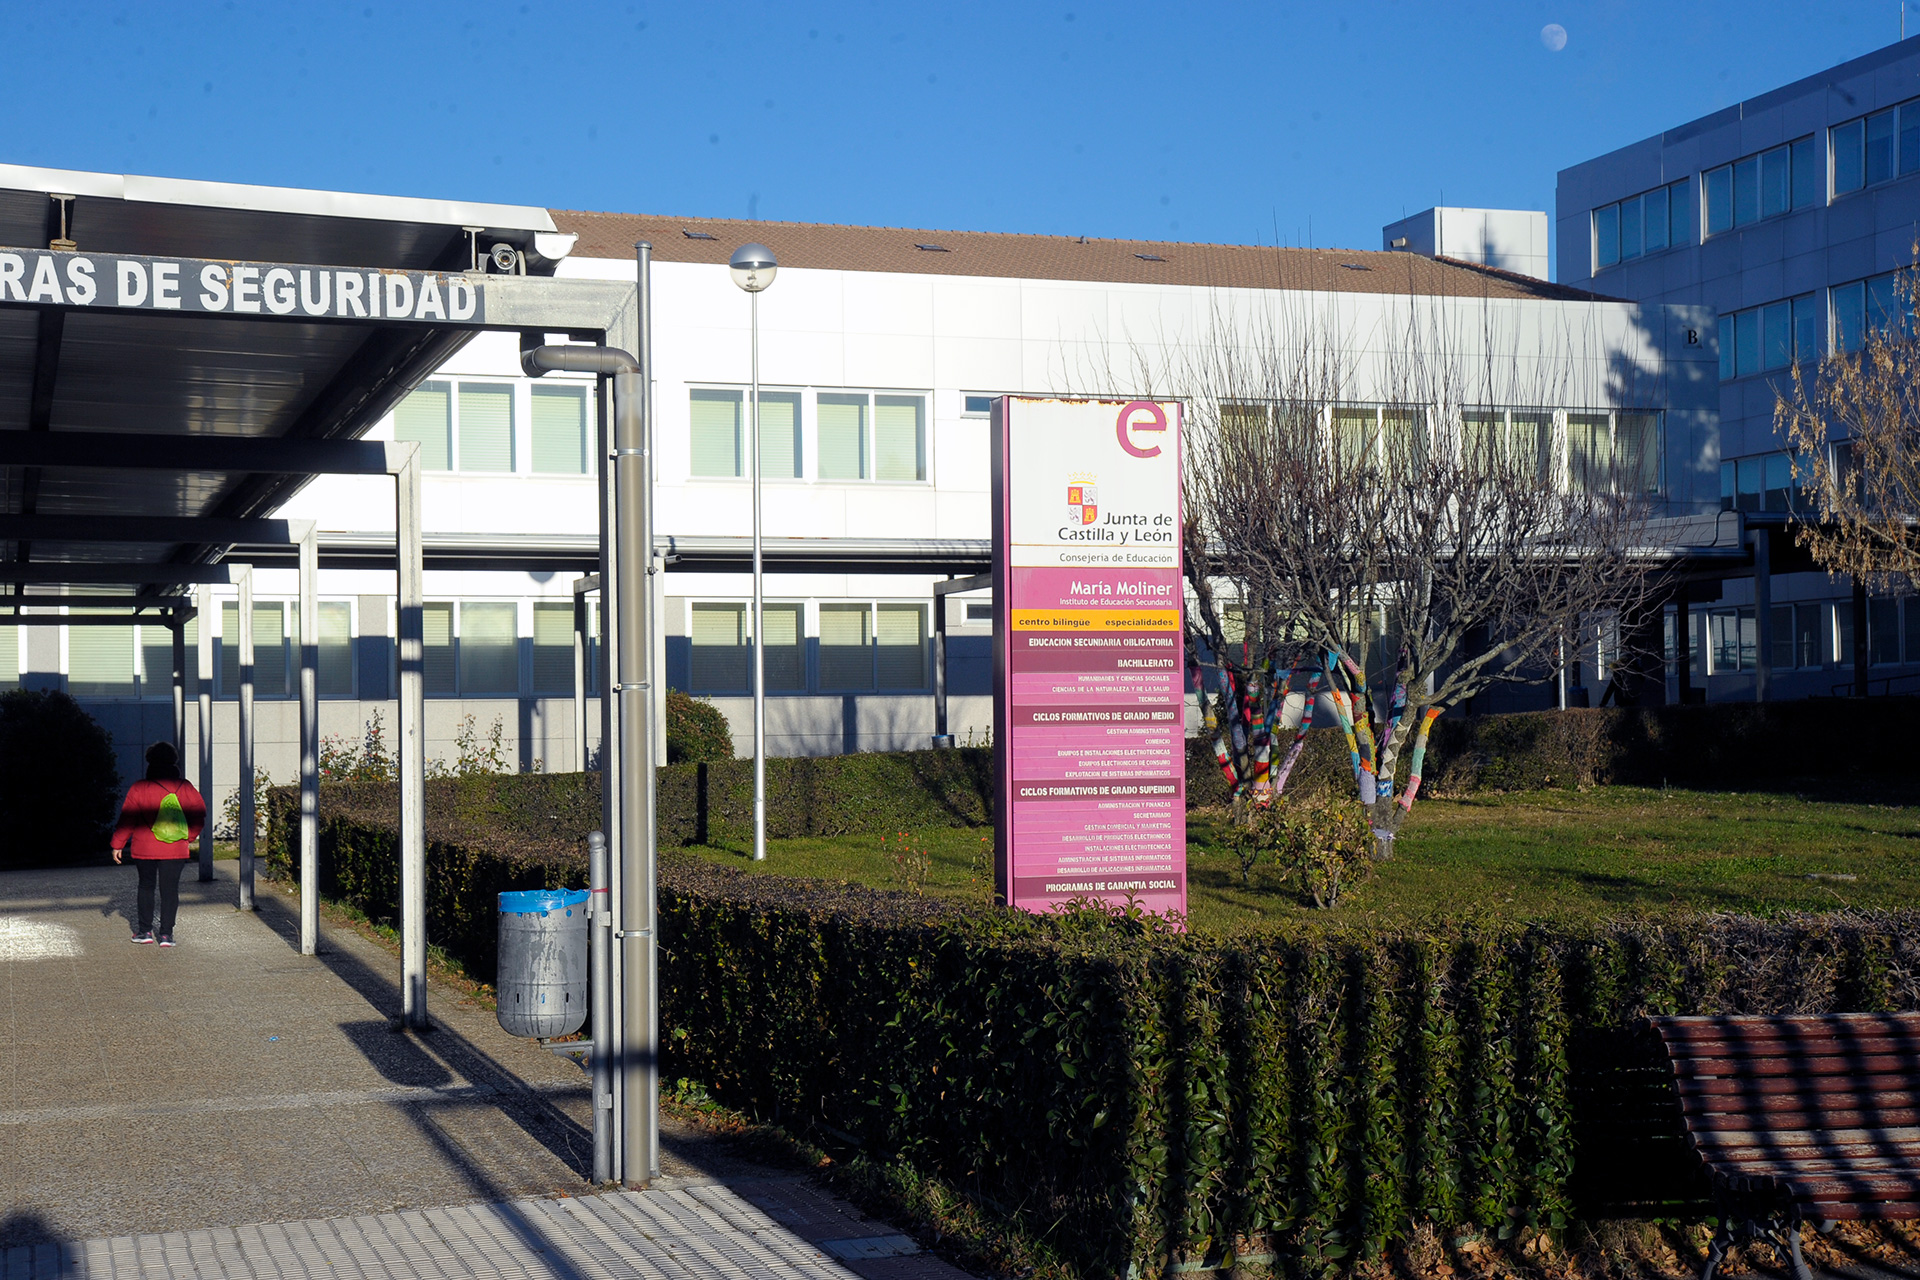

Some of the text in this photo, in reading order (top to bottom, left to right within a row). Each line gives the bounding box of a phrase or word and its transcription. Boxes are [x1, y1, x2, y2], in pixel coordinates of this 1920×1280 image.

[0, 253, 477, 320] RAS DE SEGURIDAD
[1688, 329, 1698, 344] B
[1103, 513, 1172, 526] Junta de
[1058, 527, 1172, 545] Castilla y León
[1112, 553, 1123, 562] de
[1126, 554, 1172, 563] Educación
[1070, 581, 1173, 596] María Moliner
[1100, 598, 1134, 606] Educación
[1053, 618, 1090, 627] bilingüe
[1105, 618, 1173, 627] especialidades
[1074, 638, 1121, 646] SECUNDARIA
[1124, 638, 1174, 646] OBLIGATORIA
[1117, 659, 1174, 667] BACHILLERATO
[1033, 713, 1060, 721] CICLOS
[1062, 712, 1110, 721] FORMATIVOS
[1124, 712, 1150, 720] GRADO
[1152, 712, 1174, 720] MEDIO
[1020, 785, 1175, 796] CICLOS FORMATIVOS DE GRADO SUPERIOR
[1046, 883, 1093, 892] PROGRAMAS
[1095, 882, 1105, 891] DE
[1149, 880, 1176, 889] SOCIAL
